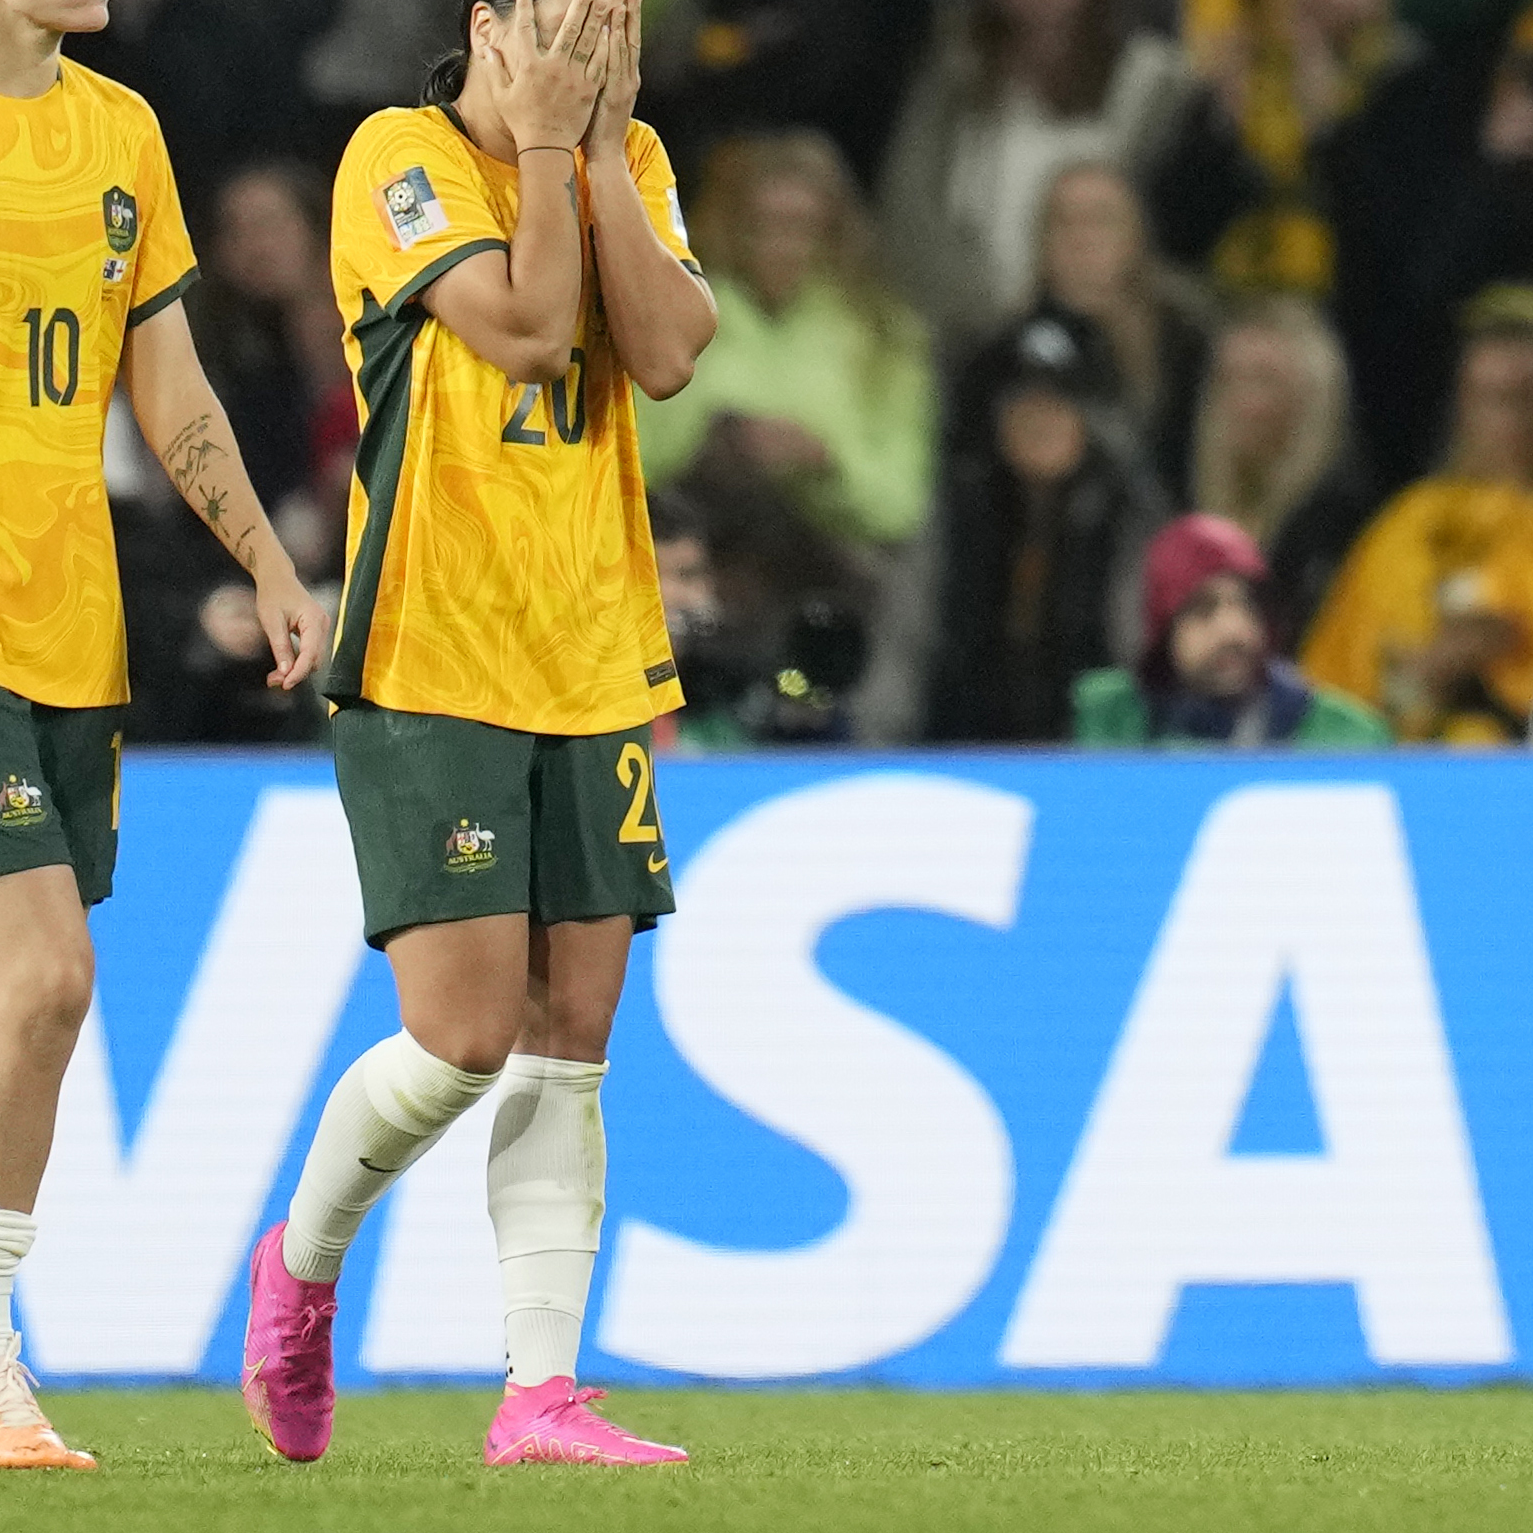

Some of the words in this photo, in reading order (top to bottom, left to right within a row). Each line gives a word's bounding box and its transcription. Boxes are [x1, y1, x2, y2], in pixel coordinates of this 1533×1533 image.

[22, 308, 79, 407] 10
[501, 347, 586, 446] 20
[448, 851, 493, 865] AUSTRALIA
